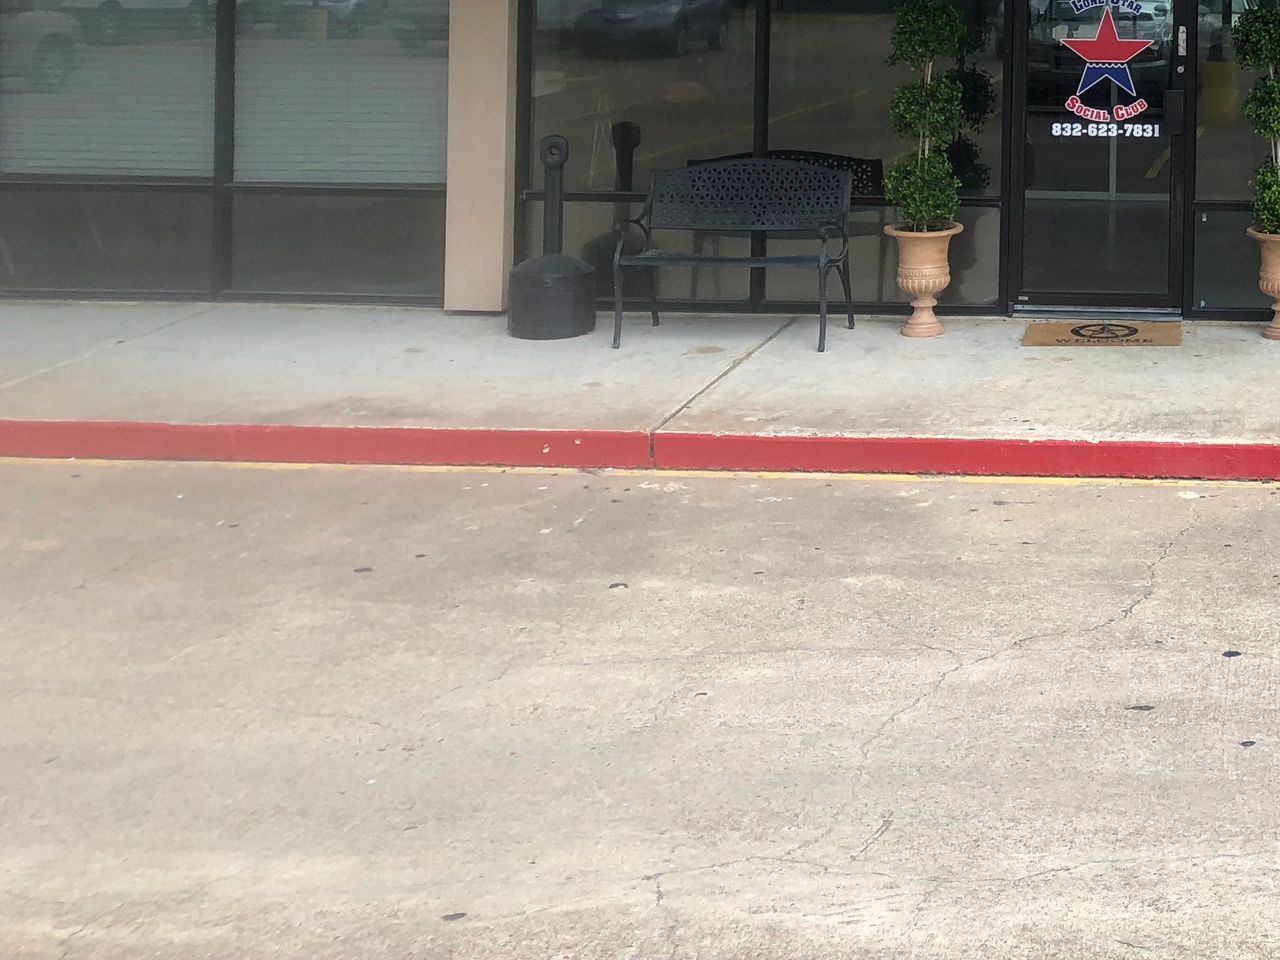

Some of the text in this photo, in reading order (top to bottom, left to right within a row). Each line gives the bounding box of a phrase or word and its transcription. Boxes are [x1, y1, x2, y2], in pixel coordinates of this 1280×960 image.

[1065, 95, 1148, 123] SOCIAL CLUB
[1051, 123, 1160, 138] 832-623-7831
